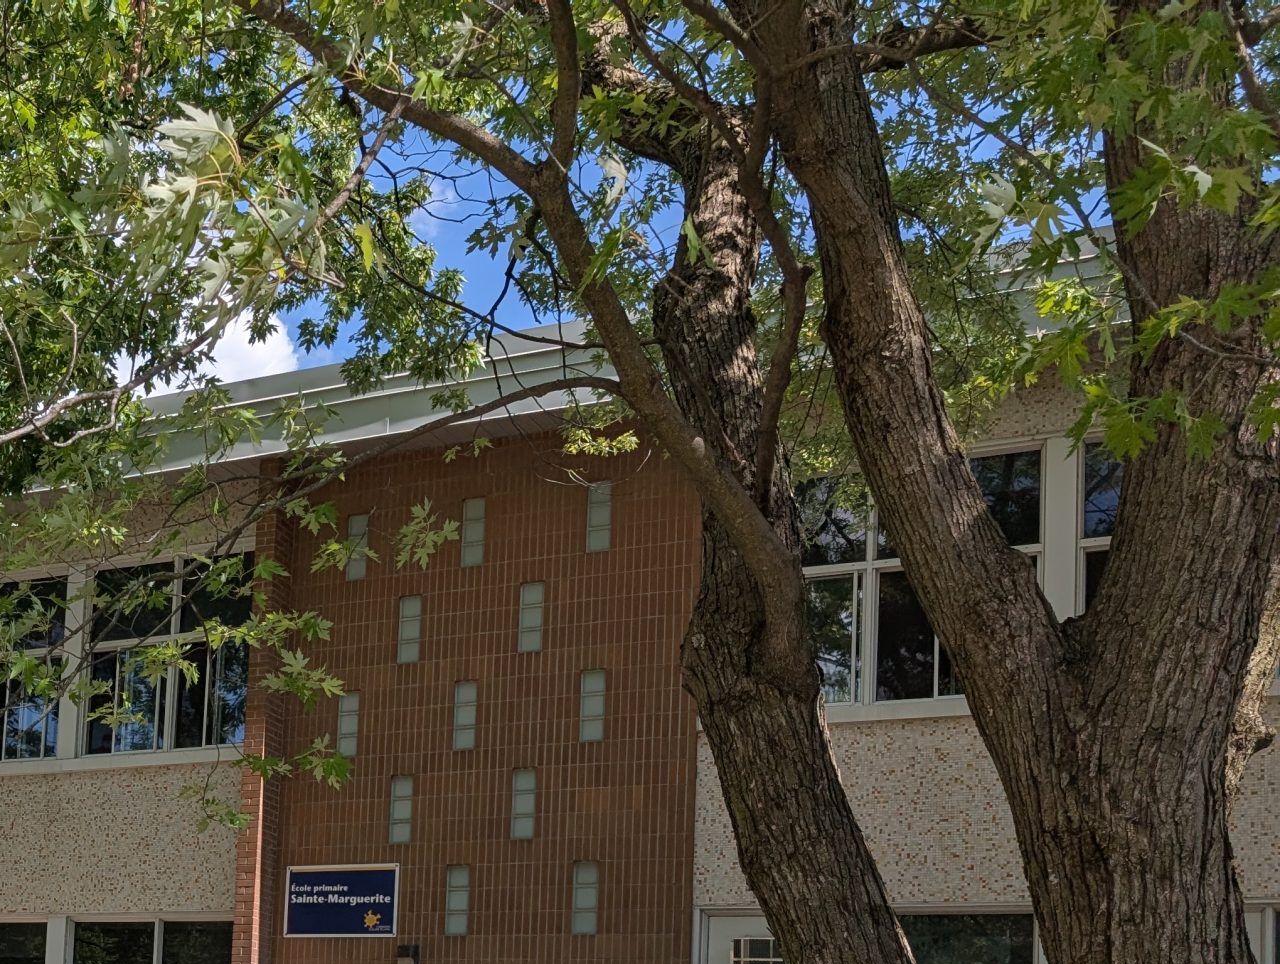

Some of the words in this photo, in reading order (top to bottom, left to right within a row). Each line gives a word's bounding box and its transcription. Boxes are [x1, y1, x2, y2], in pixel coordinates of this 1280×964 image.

[291, 883, 311, 892] École
[314, 884, 348, 893] primaire
[291, 894, 391, 905] Sainte-Marguerite
